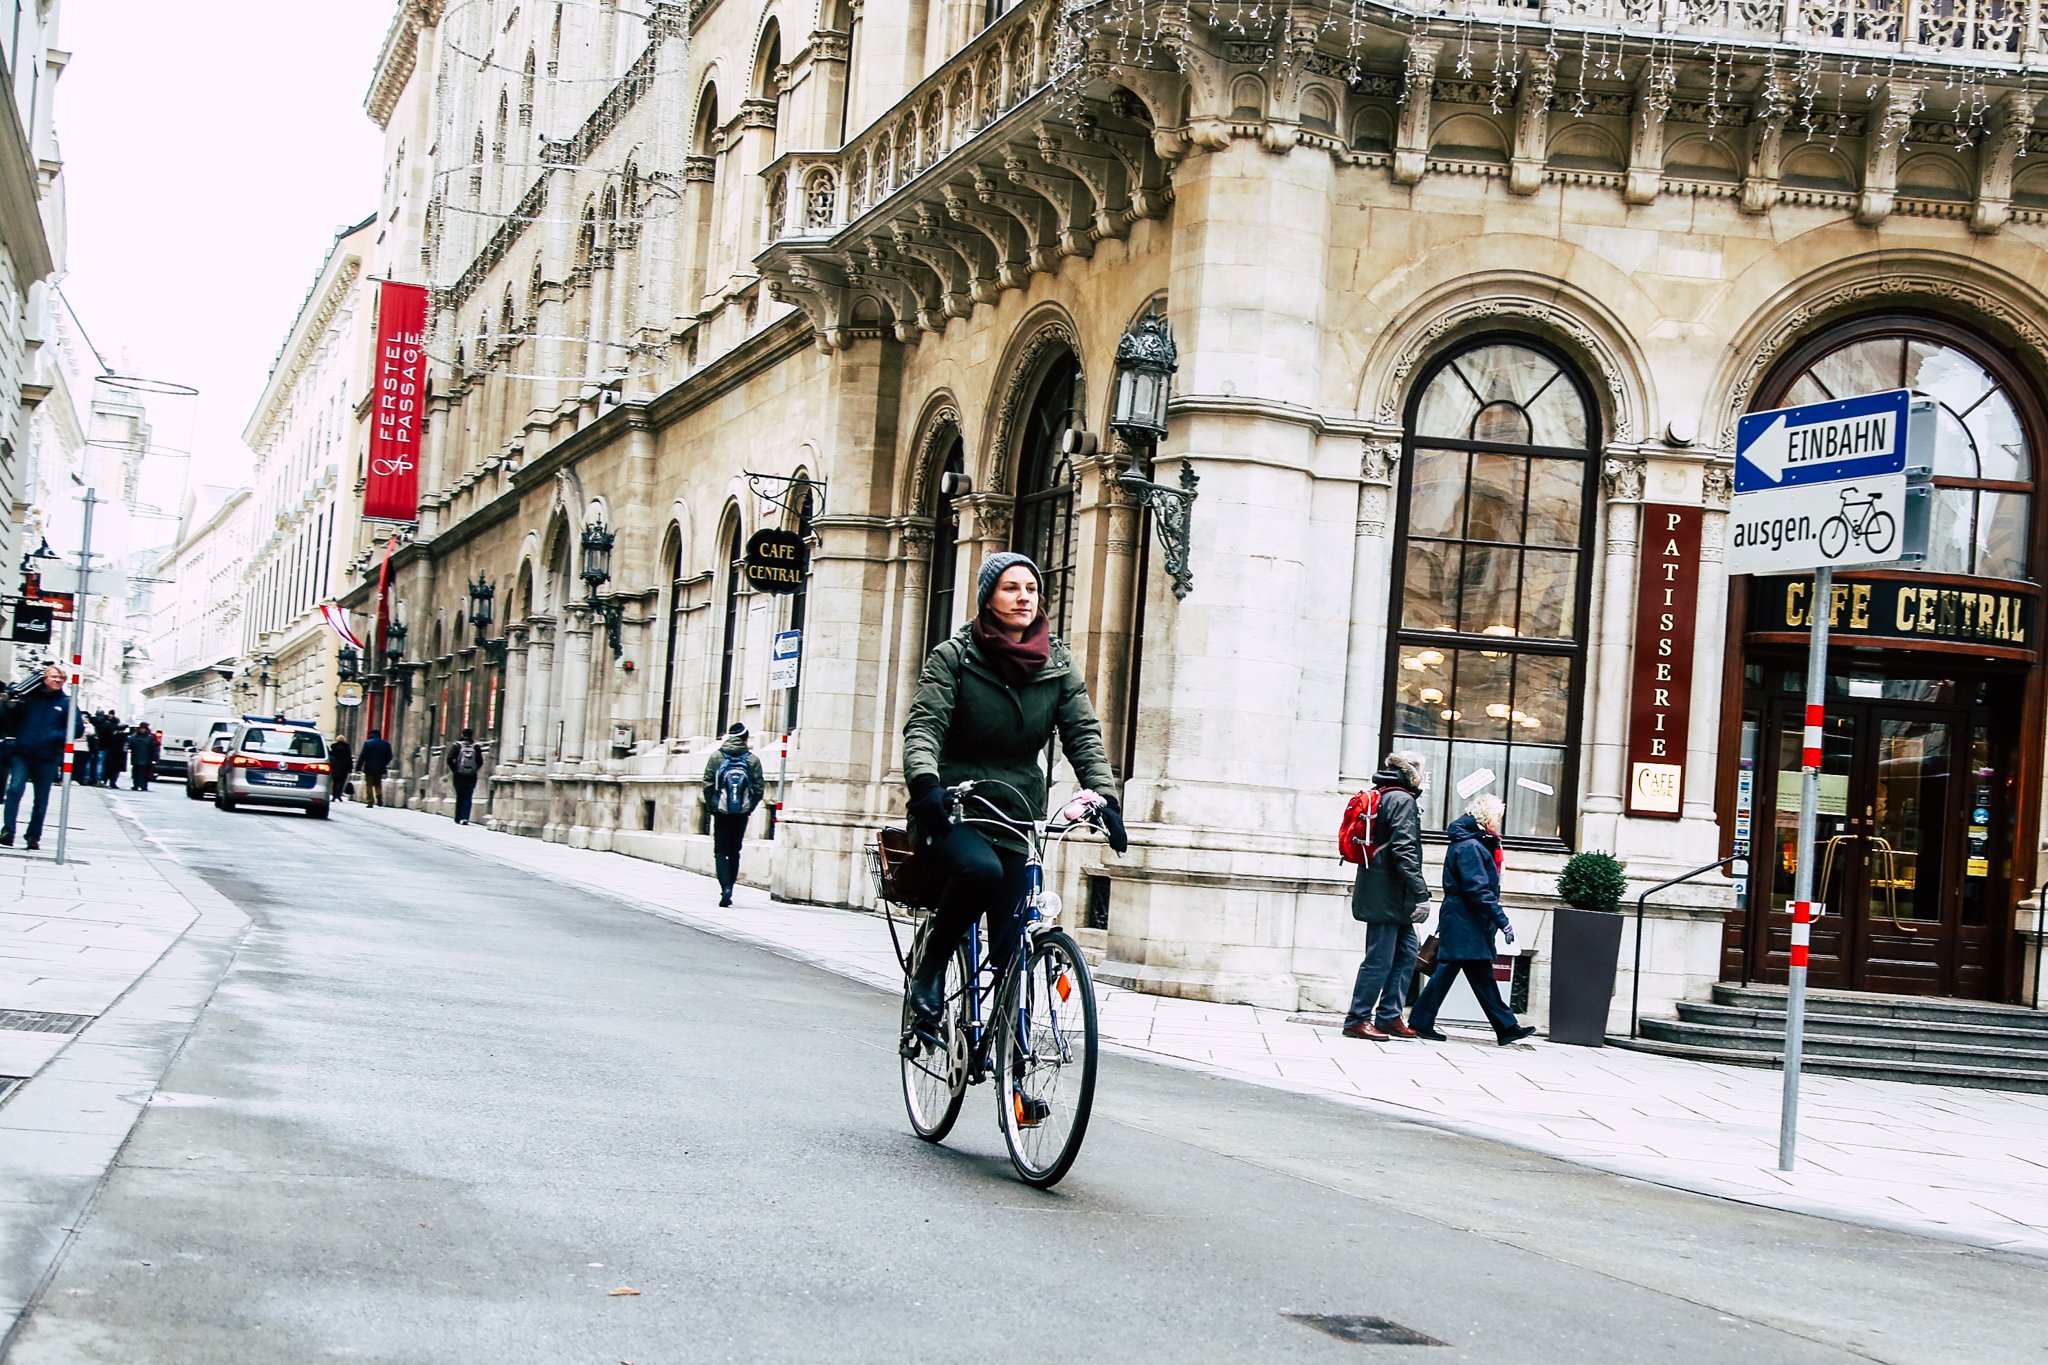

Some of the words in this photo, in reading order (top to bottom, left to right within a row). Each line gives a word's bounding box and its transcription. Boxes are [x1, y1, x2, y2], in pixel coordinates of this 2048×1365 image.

[380, 331, 402, 441] FERSTEL
[397, 331, 420, 443] PASSAGE
[1788, 417, 1886, 463] EINBAHN
[759, 542, 795, 560] CAFE
[1734, 515, 1817, 552] ausgen.
[748, 565, 803, 583] CENTRAL
[1650, 513, 1682, 757] PATISSERIE
[1896, 586, 2025, 643] CENTRAL
